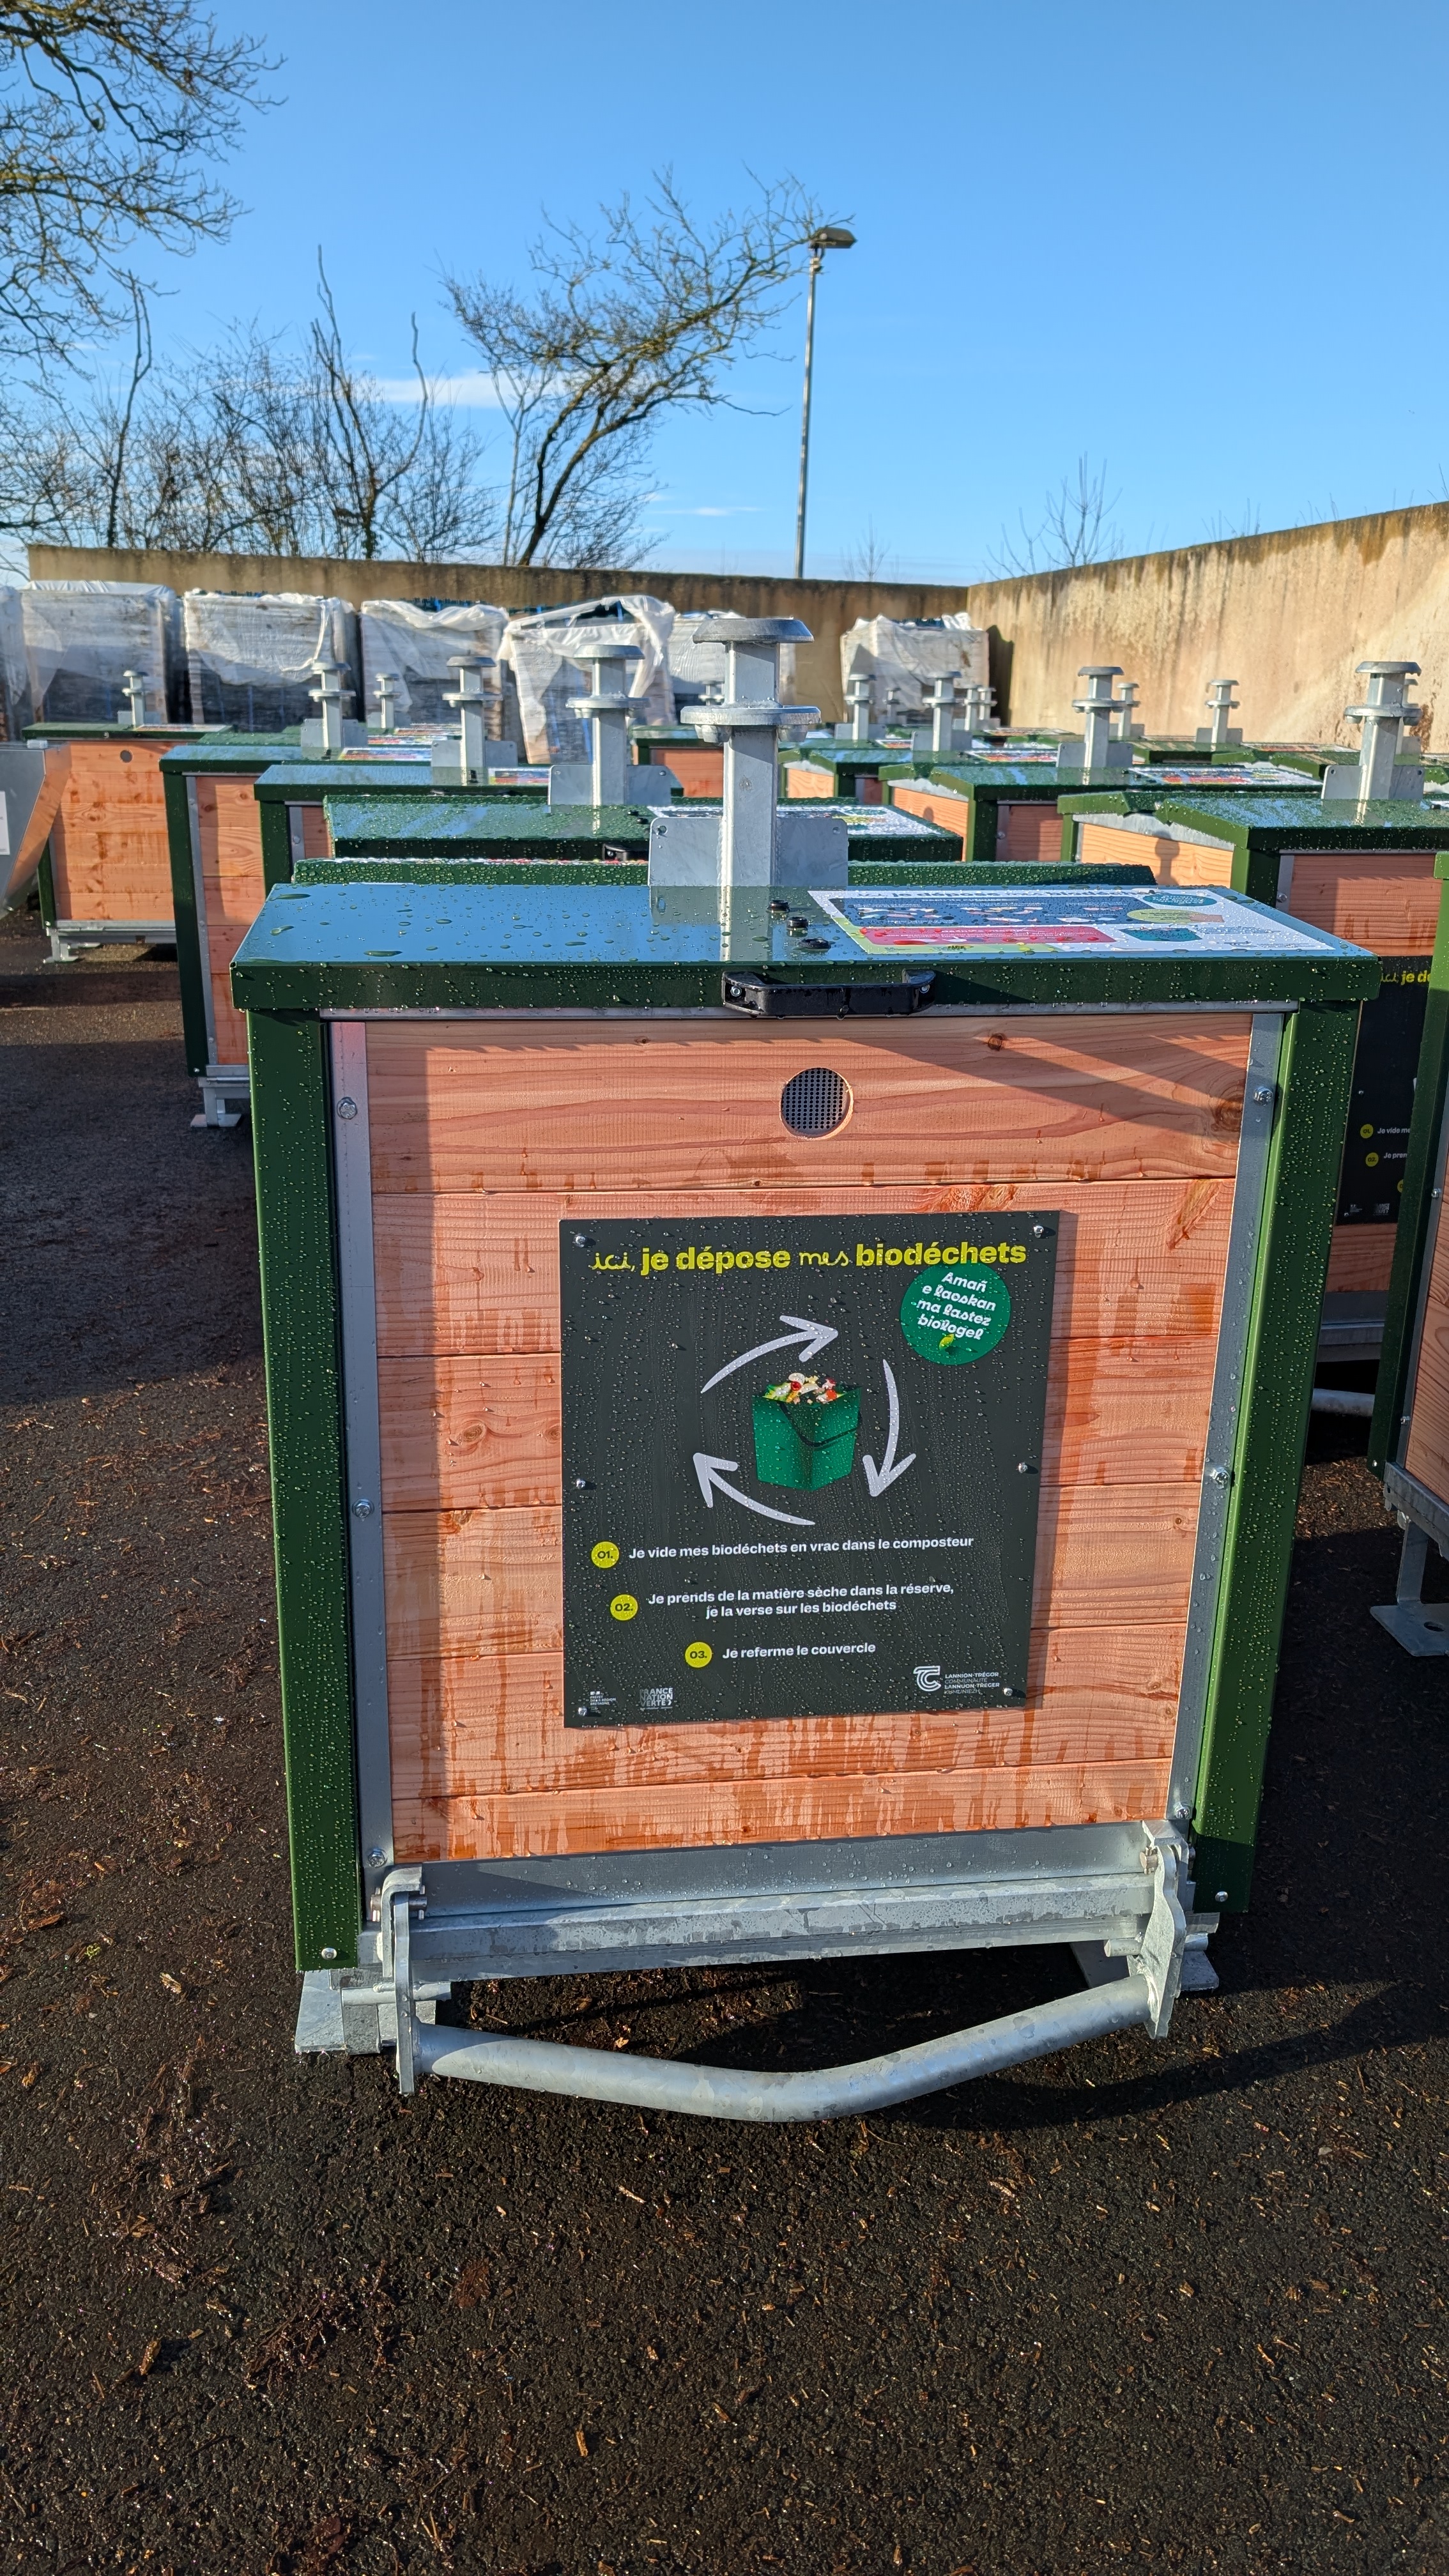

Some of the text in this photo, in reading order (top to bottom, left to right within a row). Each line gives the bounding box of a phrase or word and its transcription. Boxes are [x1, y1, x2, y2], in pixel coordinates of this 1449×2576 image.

[1400, 970, 1415, 986] je
[588, 1241, 1027, 1275] ici, je dépose mes biodéchets
[942, 1272, 988, 1292] Amañ
[922, 1284, 997, 1312] e laoskan
[916, 1300, 992, 1326] ma lastez
[917, 1314, 985, 1340] biologel
[597, 1537, 974, 1559] 01. Je vide mes biodéchets en vrac dans le composteur
[615, 1583, 954, 1612] 02. Je prends de la matière sèche dans la réserve,
[705, 1600, 897, 1620] je la verse sur les biodéchets
[689, 1643, 876, 1659] 03. Je referme le couvercle
